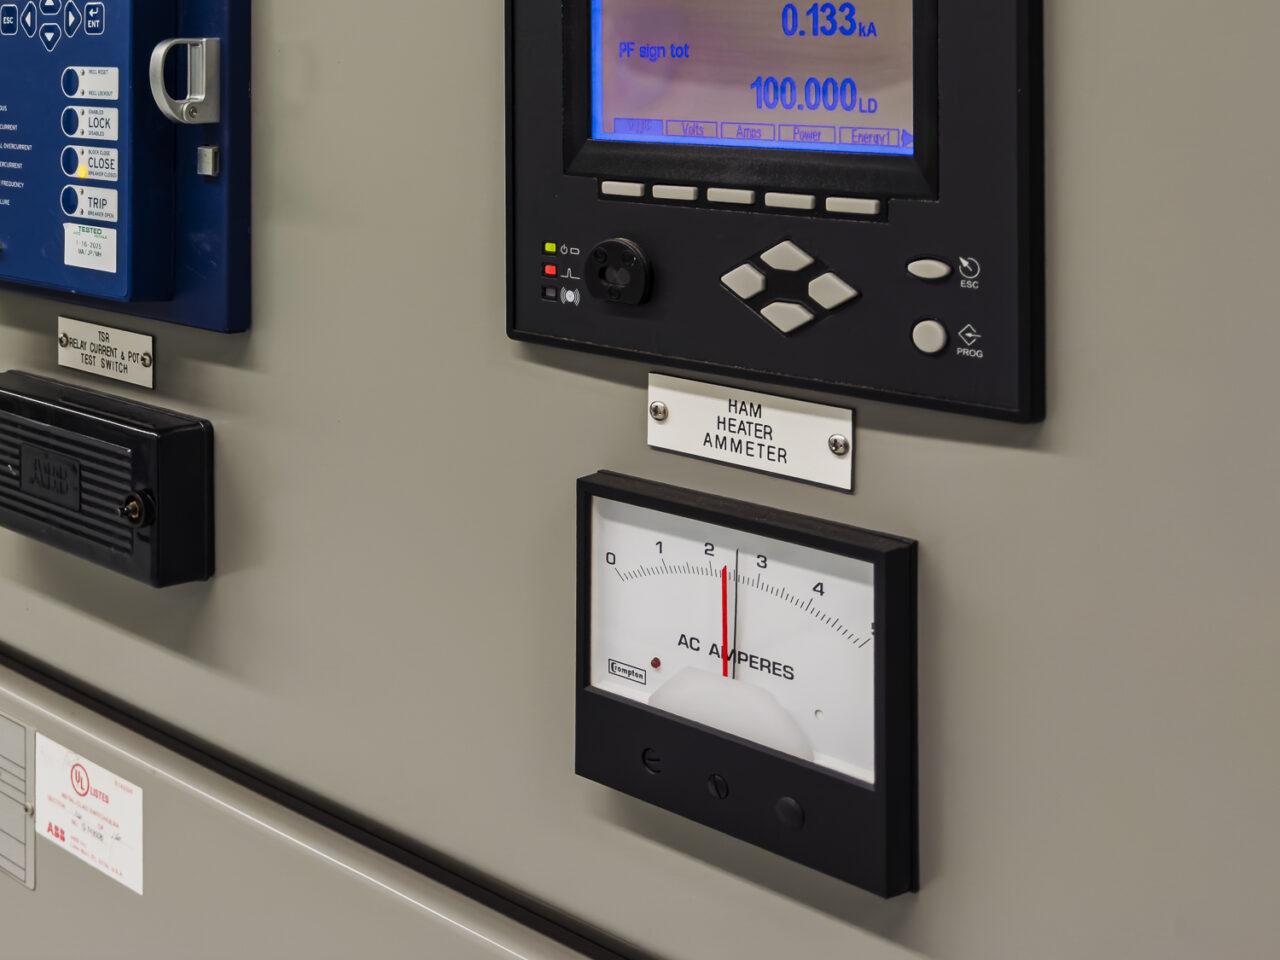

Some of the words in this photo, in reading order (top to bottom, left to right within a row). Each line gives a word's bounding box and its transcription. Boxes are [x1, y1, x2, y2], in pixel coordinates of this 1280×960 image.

[88, 20, 100, 28] ENT
[619, 42, 634, 58] PF
[639, 43, 665, 62] sign
[670, 43, 689, 59] tot
[89, 117, 111, 129] LOCK
[682, 123, 704, 136] Volts
[736, 125, 761, 139] Amps
[793, 127, 822, 142] Power
[88, 157, 115, 170] CLOSE
[88, 197, 107, 209] TRIP
[78, 226, 102, 234] TESTED
[960, 279, 979, 290] ESC
[98, 330, 110, 343] TSR
[69, 337, 87, 351] RELAY
[90, 342, 117, 359] CURRENT
[120, 351, 125, 360] &
[128, 350, 139, 364] POT
[956, 347, 983, 359] PROG
[81, 353, 96, 367] TEST
[101, 358, 128, 374] SWITCH
[728, 397, 763, 419] HAM
[717, 416, 773, 441] HEATER
[703, 433, 788, 465] AMMETER
[704, 543, 715, 556] 2
[606, 552, 616, 565] 0
[756, 555, 768, 569] 3
[812, 582, 825, 596] 4
[678, 634, 700, 652] AC
[708, 643, 795, 681] AMPERES
[610, 662, 644, 680] Crompton
[75, 769, 85, 790] UL
[90, 786, 109, 804] LISTED
[47, 821, 65, 842] ABB
